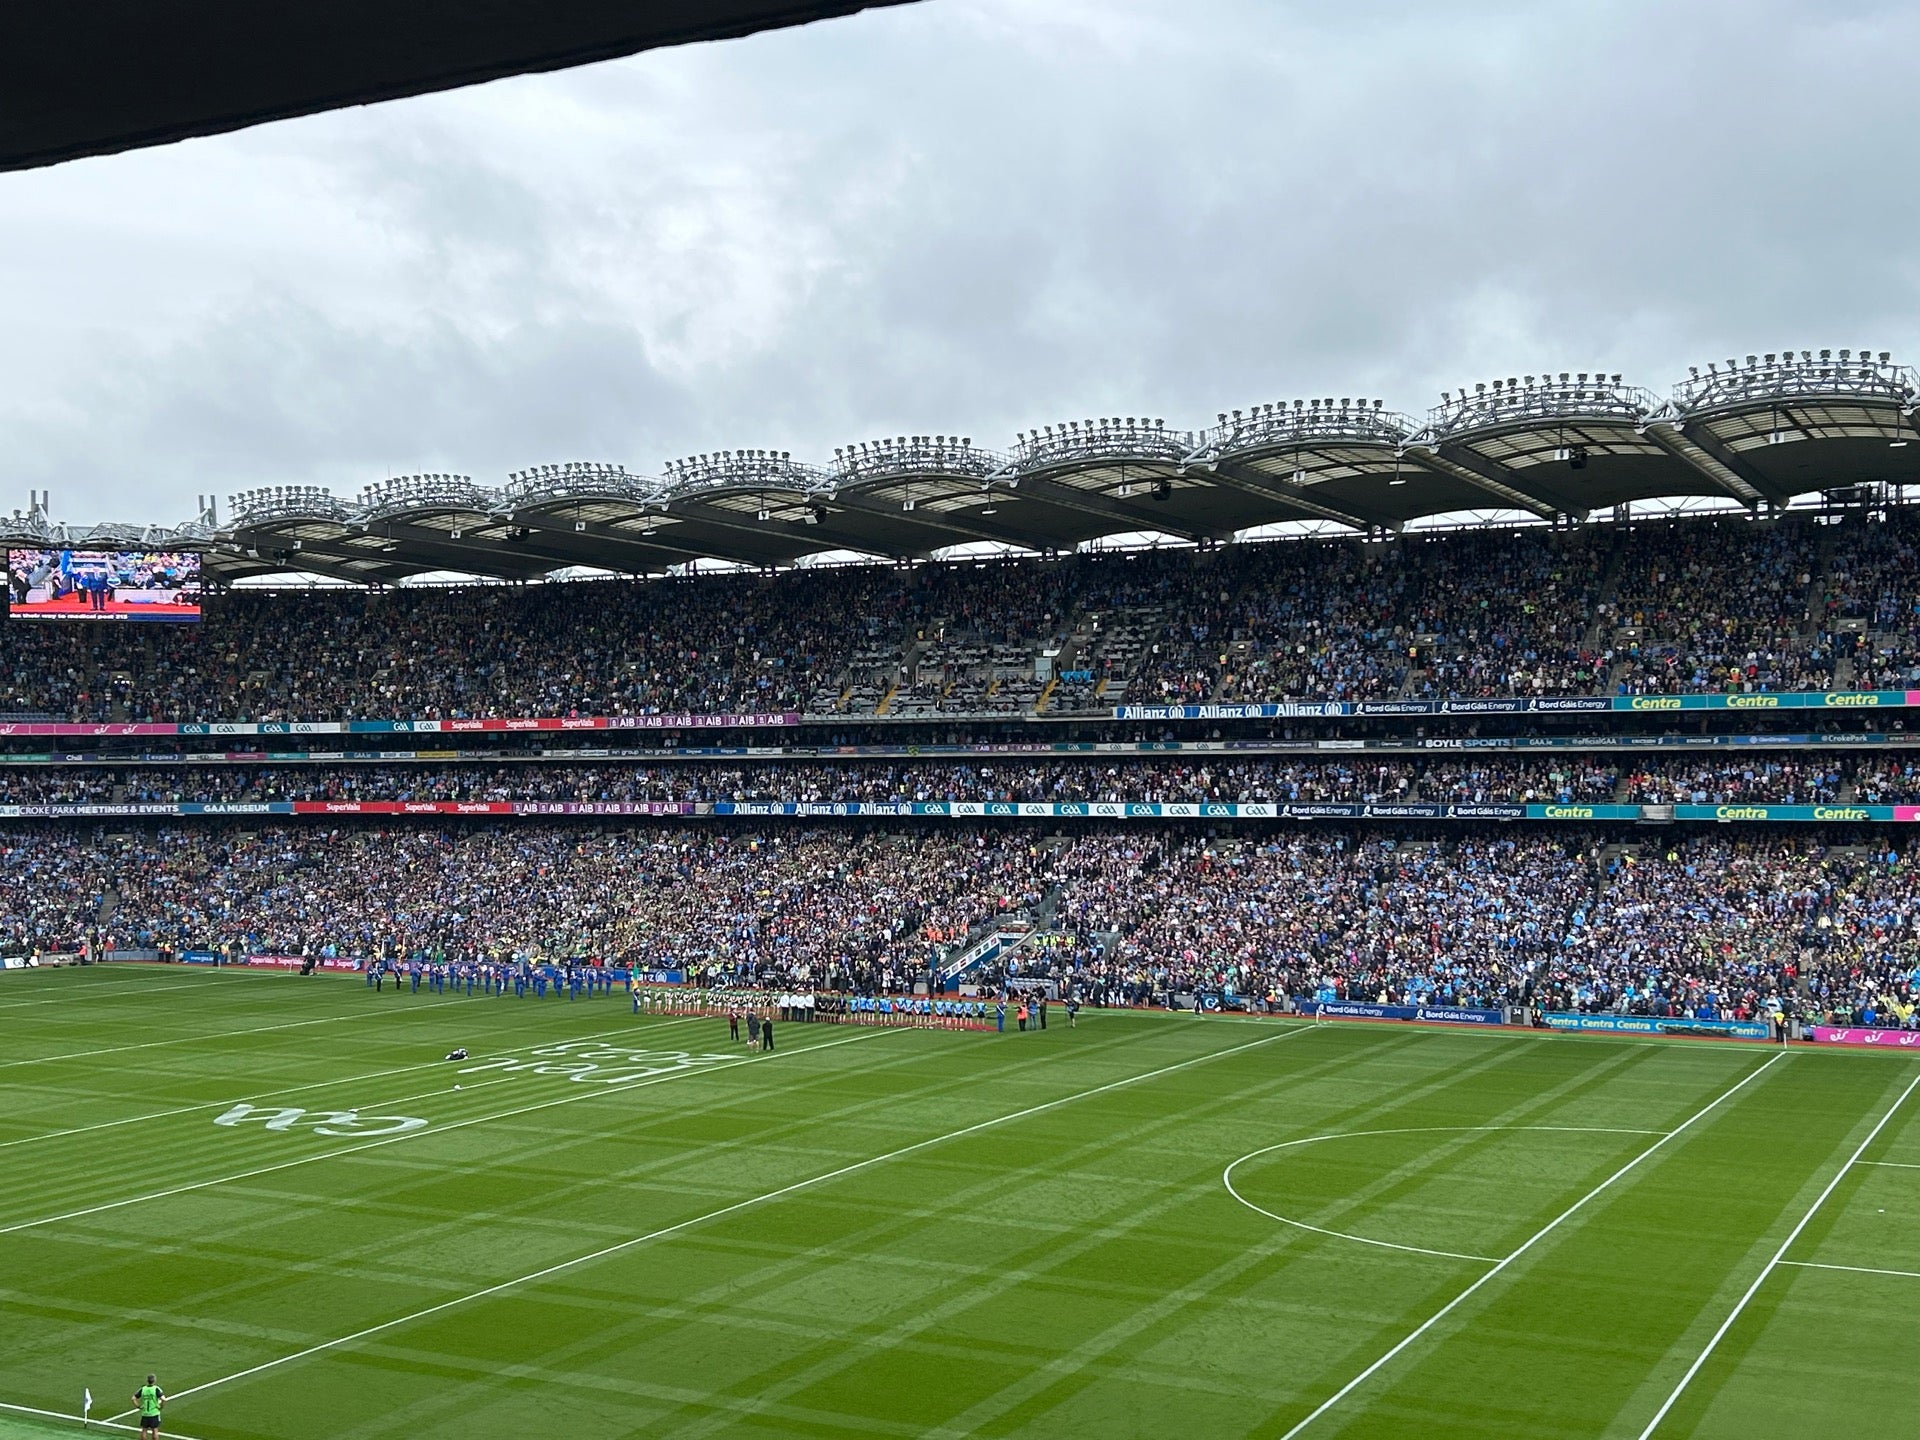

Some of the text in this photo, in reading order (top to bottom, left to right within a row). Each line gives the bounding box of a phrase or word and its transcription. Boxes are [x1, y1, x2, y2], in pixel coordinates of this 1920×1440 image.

[1577, 700, 1606, 708] Energy
[1632, 697, 1681, 709] Centra
[1727, 696, 1778, 708] Centra
[1825, 694, 1878, 705] Centra
[1198, 706, 1243, 718] Allianz
[1276, 704, 1322, 716] Allianz
[1401, 704, 1427, 712] Energy
[1123, 707, 1166, 719] Allianz
[506, 719, 538, 729] SuperValu
[562, 719, 594, 729] SuperValu
[647, 717, 662, 726] AIB
[676, 717, 692, 726] AIB
[706, 717, 721, 725] AIB
[739, 716, 755, 725] AIB
[768, 715, 783, 724] AIB
[452, 721, 483, 730] SuperValu
[1426, 739, 1510, 748] BOYLE SPORTS
[20, 807, 49, 815] CROKE
[52, 806, 75, 814] PARK
[139, 805, 179, 813] EVENTS
[327, 803, 360, 812] SuperValu
[405, 803, 436, 812] SuperValu
[457, 803, 489, 813] SuperValu
[523, 804, 537, 812] AIB
[549, 803, 564, 812] AIB
[579, 803, 593, 812] AIB
[605, 803, 620, 812] AIB
[634, 804, 649, 812] AIB
[663, 804, 678, 812] AIB
[734, 803, 768, 814] Allianz
[795, 803, 831, 815] Allianz
[858, 803, 895, 815] Allianz
[1326, 807, 1351, 815] Energy
[1373, 807, 1391, 815] Bord
[1409, 807, 1434, 816] Energy
[1457, 807, 1476, 815] Bord
[1494, 807, 1521, 816] Energy
[1545, 806, 1592, 817] Centra
[1716, 807, 1767, 818] Centra
[1360, 1008, 1383, 1016] Energy
[1426, 1010, 1443, 1018] Bord
[1460, 1013, 1485, 1022] Energy
[1545, 1017, 1578, 1027] Centra
[1581, 1019, 1614, 1028] Centra
[1617, 1020, 1650, 1030] Centra
[531, 1043, 747, 1065] 2023
